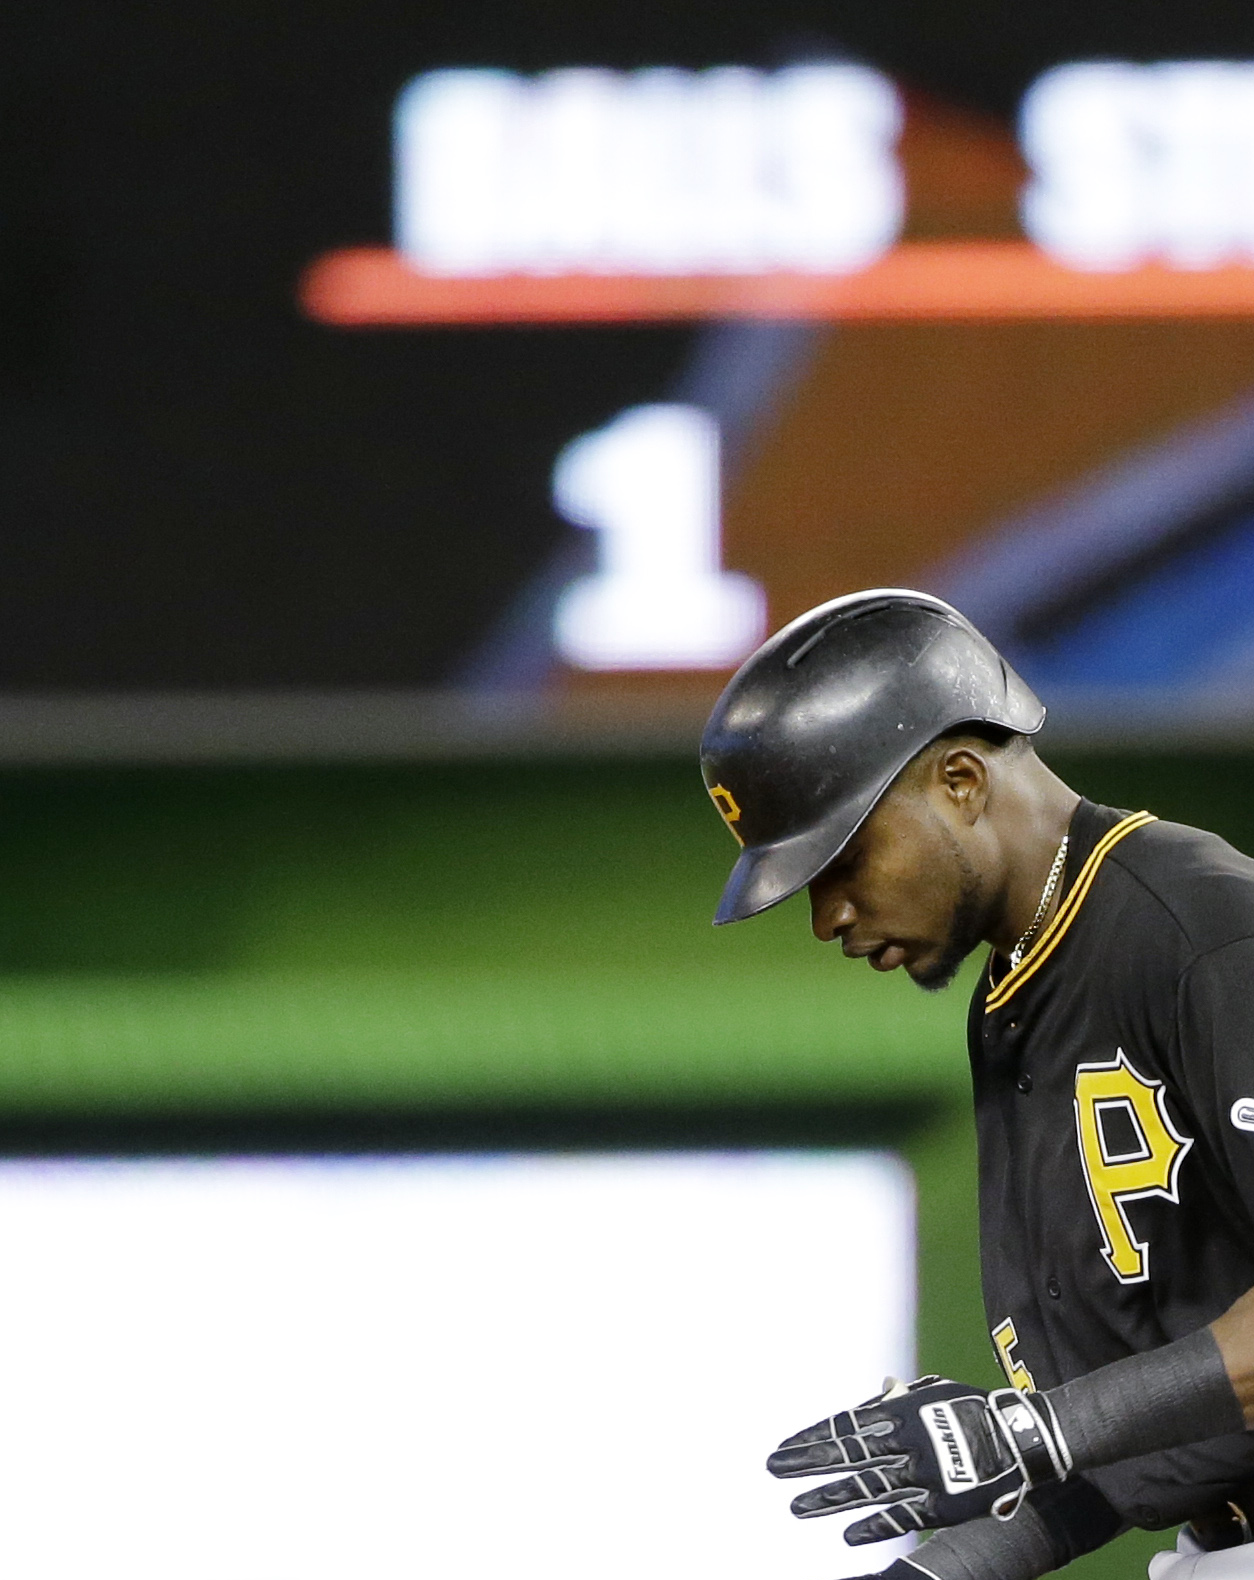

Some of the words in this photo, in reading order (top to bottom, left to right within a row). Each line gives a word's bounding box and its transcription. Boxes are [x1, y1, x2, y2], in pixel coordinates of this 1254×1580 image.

[552, 403, 766, 671] 1
[709, 782, 743, 848] P
[1073, 1046, 1195, 1285] P
[931, 1405, 975, 1483] Franklin
